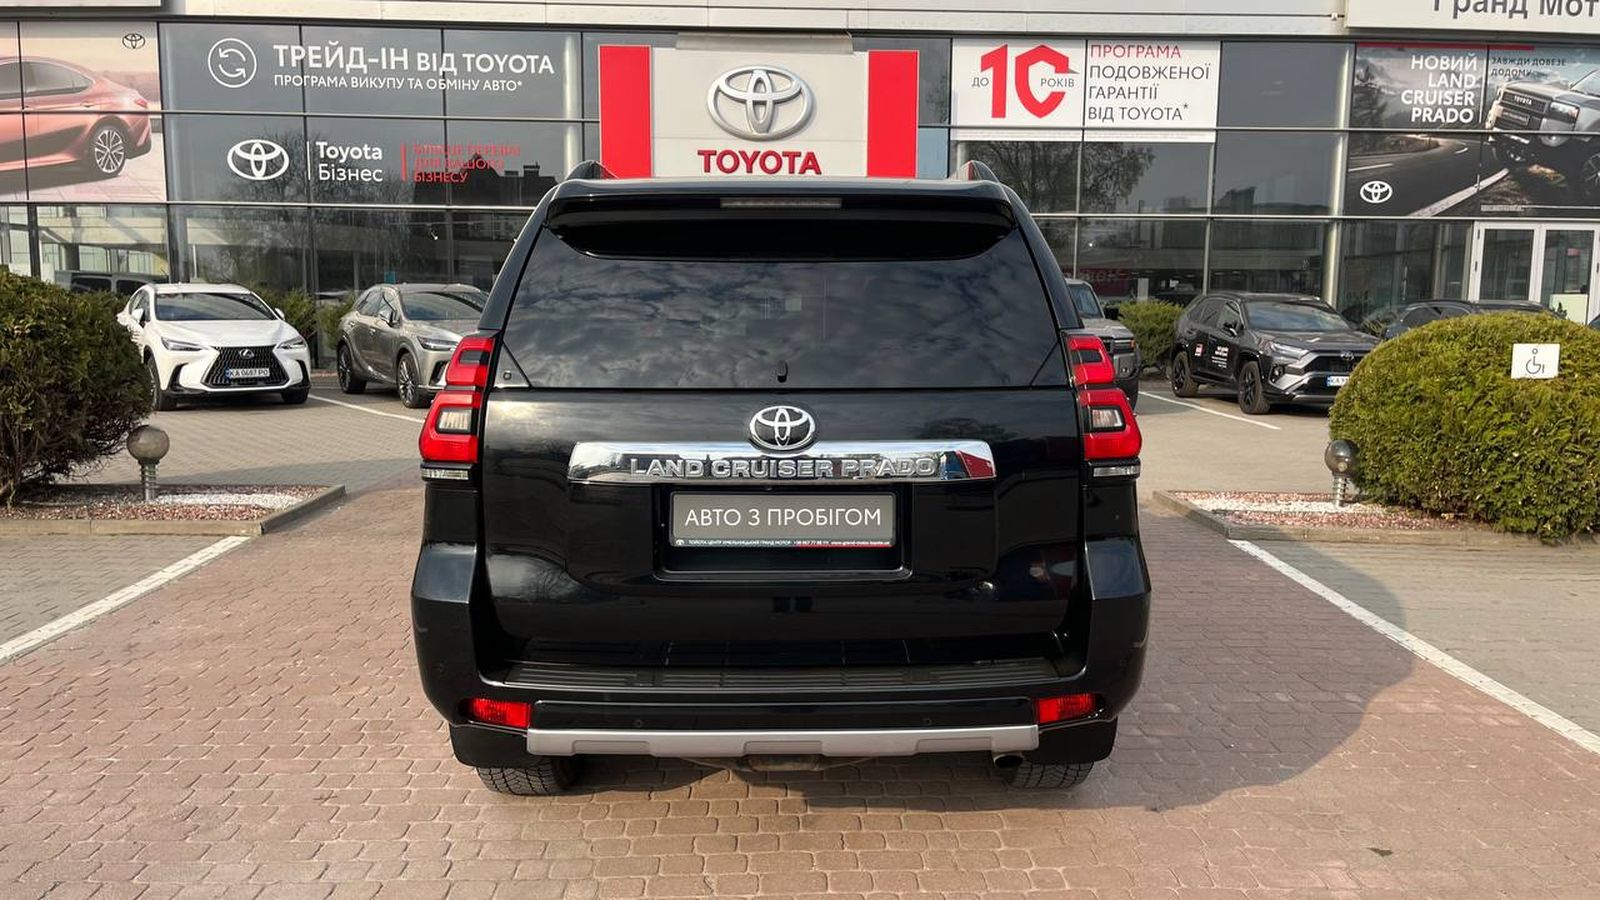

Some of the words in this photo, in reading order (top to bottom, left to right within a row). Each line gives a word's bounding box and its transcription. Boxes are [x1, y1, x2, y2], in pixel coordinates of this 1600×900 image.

[273, 41, 408, 74] ТРЕЙД-ІН
[416, 53, 458, 76] ВІД
[465, 53, 555, 75] TOYOTA
[1090, 44, 1182, 60] ПРОГРАМА
[1410, 53, 1478, 72] НОВИЙ
[1491, 56, 1530, 67] ЗАВЖДИ
[1532, 58, 1566, 67] ДОВЕЗЕ
[1089, 63, 1212, 81] ПОДОВЖЕНОЇ
[1428, 73, 1477, 88] LAND
[1491, 68, 1532, 78] ДОДОМУ
[273, 74, 347, 89] ПРОГРАМА
[350, 76, 404, 90] ВИКУПУ
[406, 78, 424, 90] ТА
[426, 79, 480, 92] ОБМІНУ
[971, 76, 990, 89] ДО
[1040, 78, 1076, 89] РОКІВ
[1088, 83, 1159, 100] ГАРАНТІЇ
[1401, 89, 1475, 107] CRUISER
[1088, 106, 1115, 122] ВІД
[1411, 107, 1474, 124] PRADO
[315, 141, 383, 164] Toyota
[697, 149, 822, 175] TOYOTA
[318, 164, 383, 183] Бізнес
[414, 171, 469, 184] БІЗНЕСУ
[630, 458, 706, 478] LAND
[711, 459, 834, 479] CRUISER
[841, 459, 936, 478] PRADO
[685, 508, 742, 527] АВТО
[748, 508, 760, 526] З
[767, 507, 882, 527] ПРОБІГОМ
